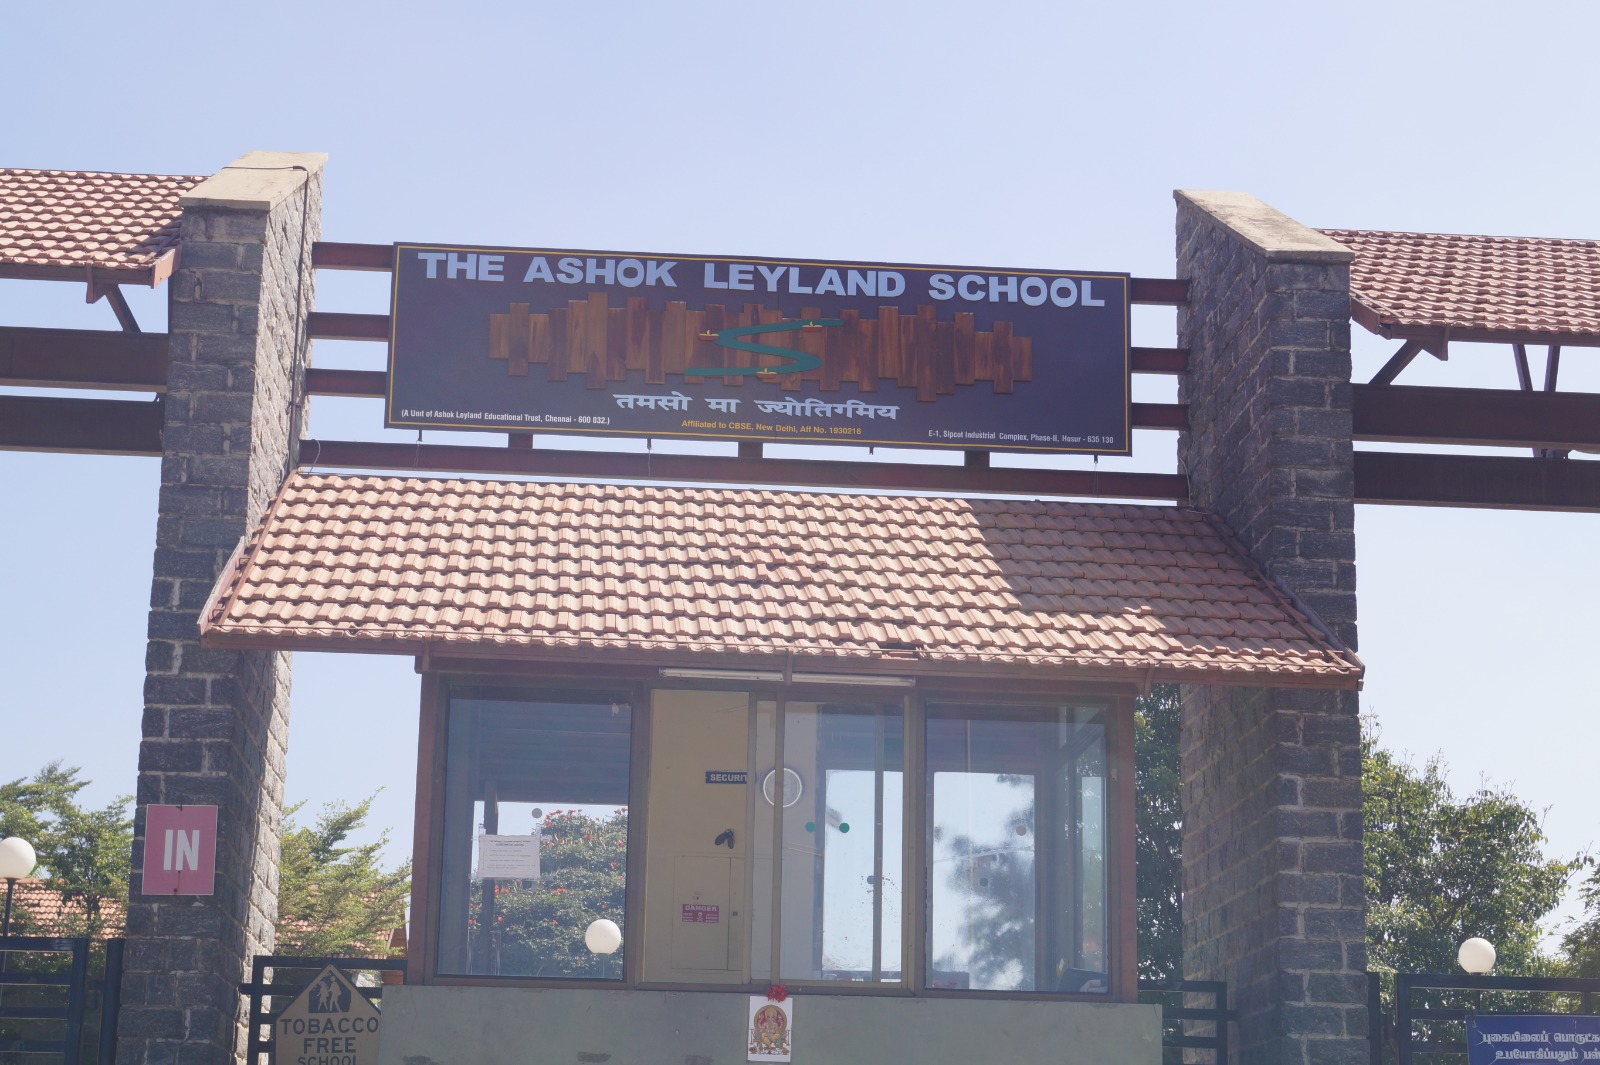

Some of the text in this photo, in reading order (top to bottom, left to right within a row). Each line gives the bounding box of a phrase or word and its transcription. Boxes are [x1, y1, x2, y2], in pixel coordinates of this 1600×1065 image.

[418, 252, 1105, 307] THE ASHOK LEYLAND SCHOOL
[612, 390, 693, 412] तमसो
[704, 398, 741, 414] मा
[401, 409, 409, 418] (A
[410, 409, 424, 417] Unit
[425, 410, 433, 418] of
[434, 410, 454, 418] Ashok
[456, 411, 482, 419] Leyland
[484, 412, 523, 421] Educational
[524, 413, 543, 422] Trust,
[545, 414, 572, 423] Chennai
[578, 415, 591, 424] 600
[682, 420, 717, 429] Affiliated
[729, 422, 754, 431] CBSE,
[756, 423, 773, 431] New
[775, 424, 798, 433] Delhi,
[813, 426, 827, 434] No.
[928, 429, 942, 438] E-1,
[943, 430, 964, 439] Sipcot
[965, 431, 996, 440] Industrial
[999, 432, 1029, 441] Complex,
[1061, 435, 1082, 443] Hosur
[1087, 435, 1100, 443] 635
[1102, 436, 1114, 444] 130
[710, 774, 747, 782] SECURIT
[163, 829, 200, 871] IN
[280, 1017, 379, 1035] TOBACCO
[303, 1037, 357, 1054] FREE
[1482, 1030, 1549, 1045] புகையிலைப்
